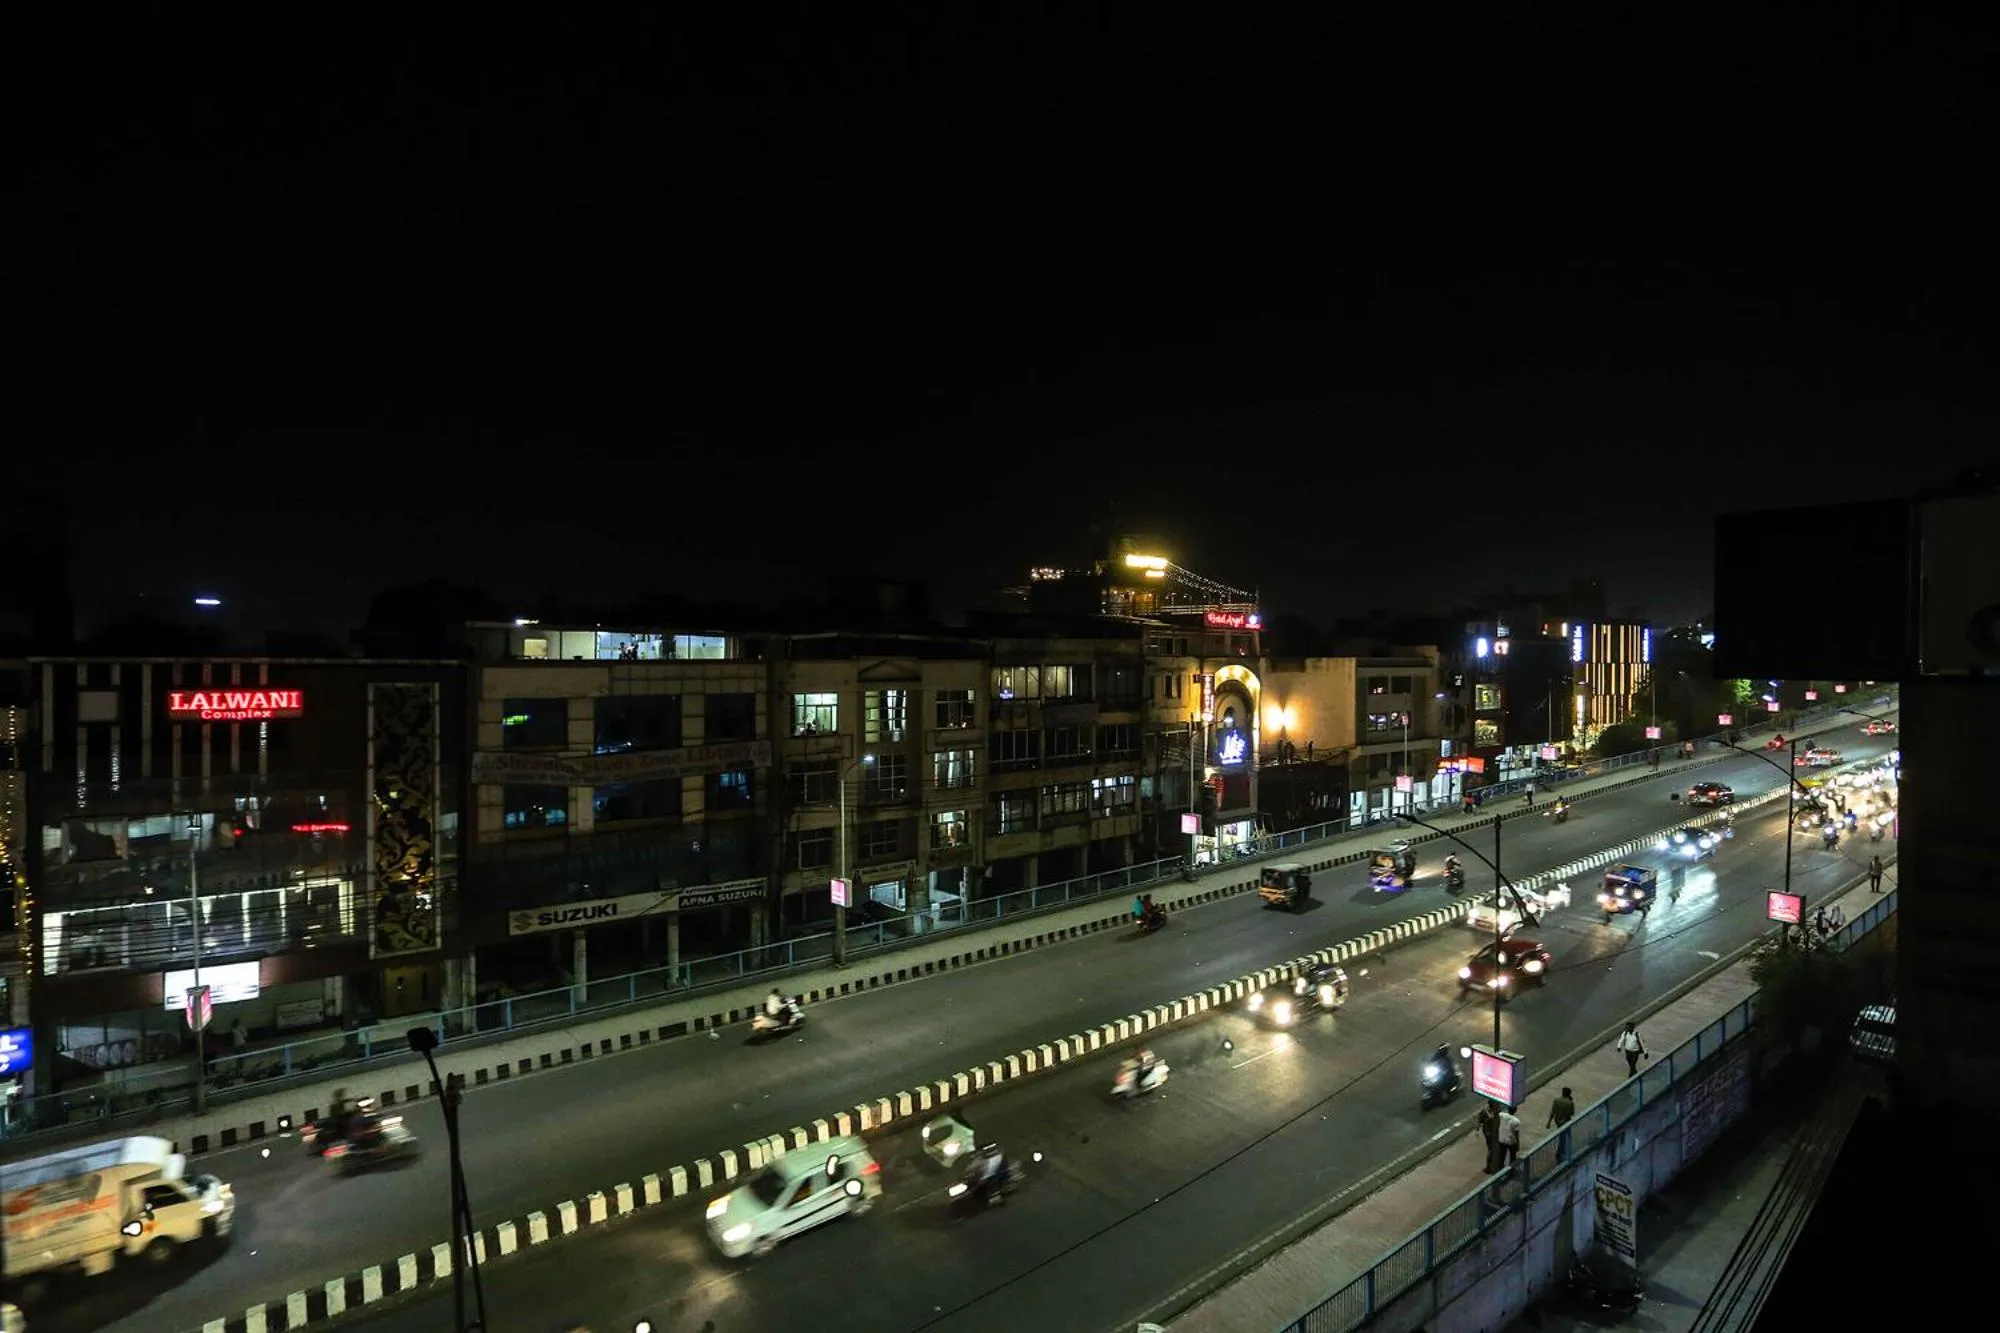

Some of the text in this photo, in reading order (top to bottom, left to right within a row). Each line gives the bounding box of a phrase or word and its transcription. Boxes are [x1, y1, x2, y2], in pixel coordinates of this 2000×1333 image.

[170, 692, 300, 711] LALWANI
[201, 709, 273, 720] Complex
[680, 888, 765, 908] APNA SUZUKI
[538, 903, 618, 926] SUZUKI
[1595, 1187, 1633, 1217] CPCT
